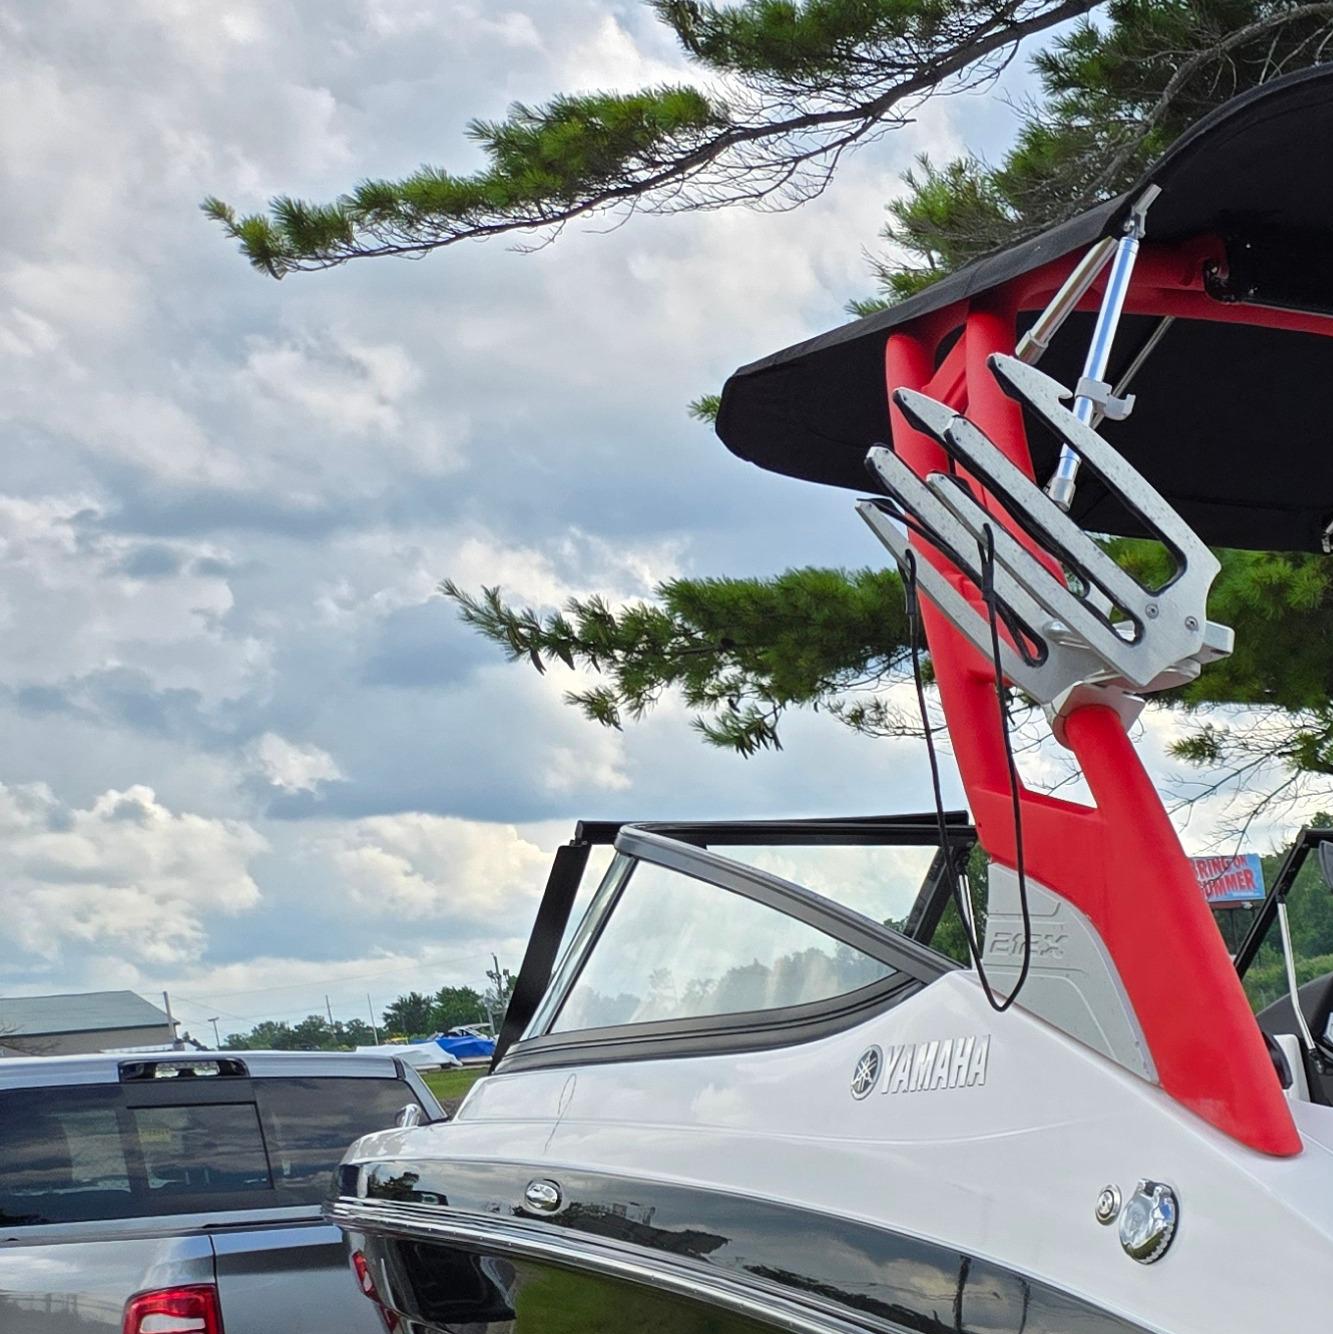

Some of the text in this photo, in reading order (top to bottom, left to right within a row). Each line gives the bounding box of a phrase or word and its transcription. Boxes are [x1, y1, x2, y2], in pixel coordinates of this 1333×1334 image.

[1192, 857, 1230, 880] RING
[1202, 869, 1256, 898] UMMER
[881, 1034, 991, 1095] YAMAHA
